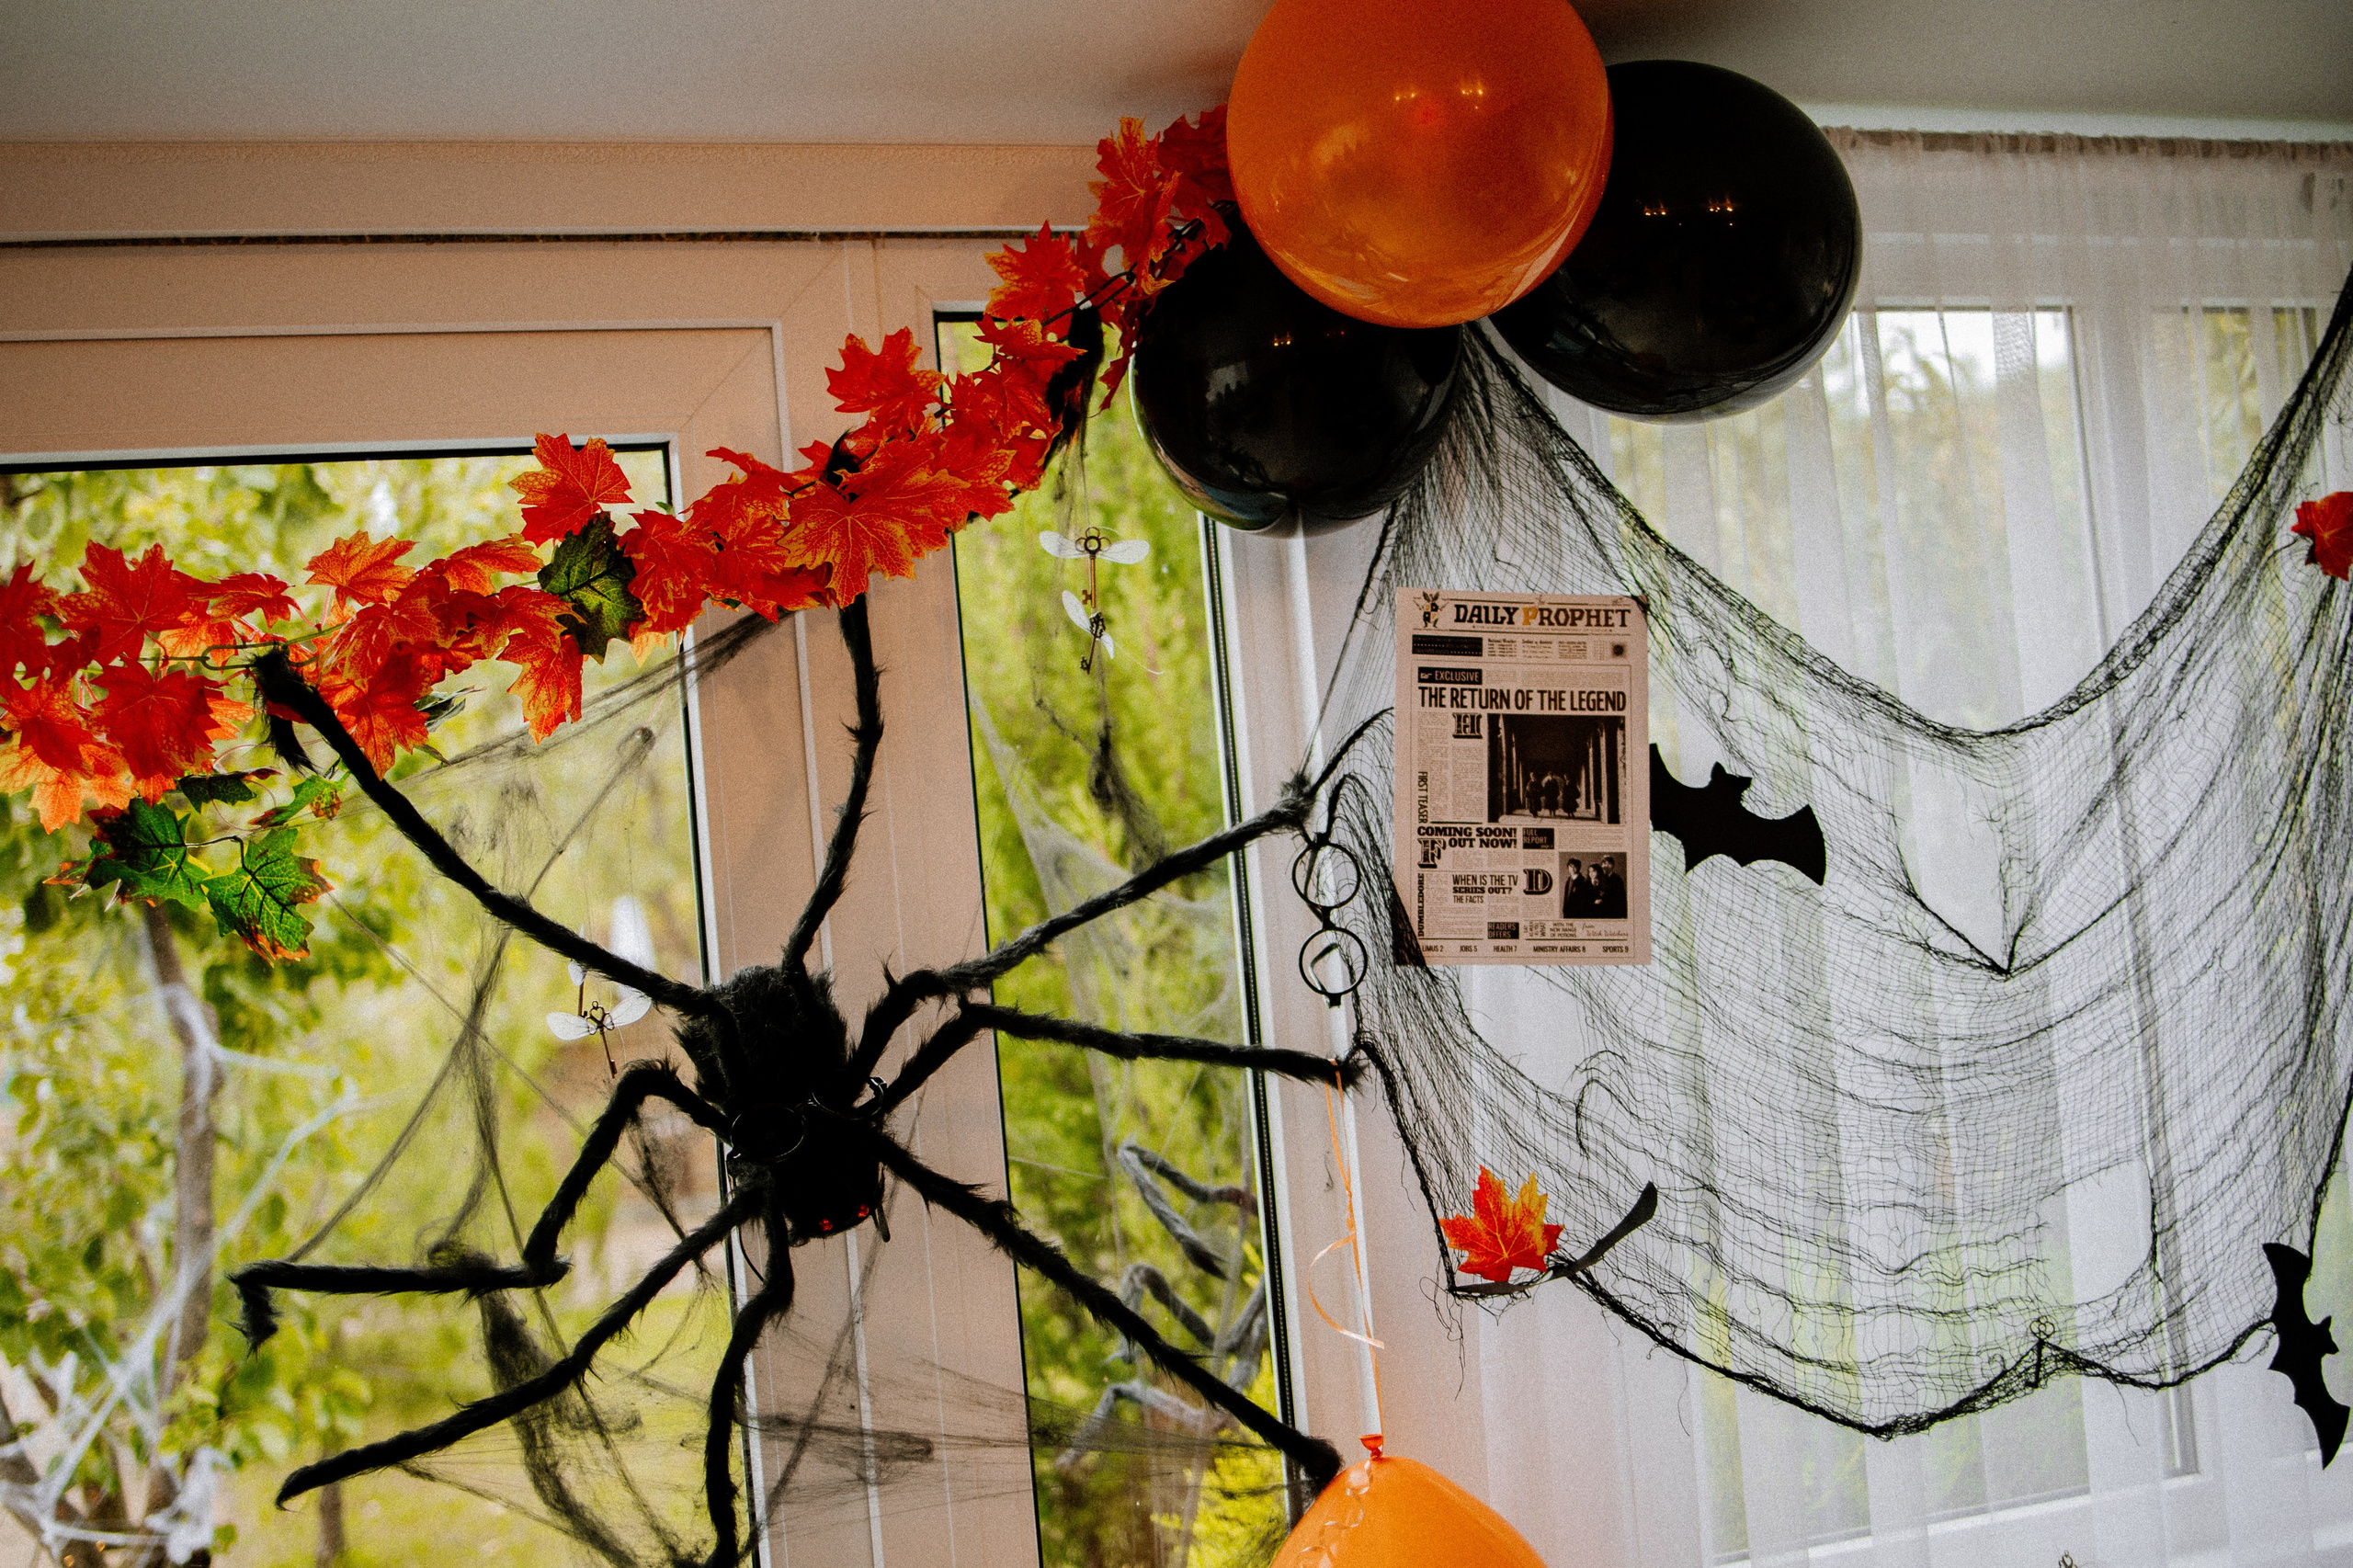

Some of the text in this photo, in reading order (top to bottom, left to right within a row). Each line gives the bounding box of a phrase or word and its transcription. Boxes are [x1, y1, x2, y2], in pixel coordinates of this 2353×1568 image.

[1454, 604, 1631, 628] DAILY PROPHET
[1435, 670, 1479, 682] EXCLUSIVE
[1418, 686, 1627, 711] THE RETURN OF THE LEGEND
[1417, 771, 1428, 824] FIRST TEASER
[1417, 826, 1518, 838] COMING SOON!
[1523, 828, 1538, 836] FULL
[1449, 837, 1518, 848] OUT NOW!
[1523, 835, 1548, 845] REPORT
[1452, 874, 1518, 886] WHEN IS THE TV
[1452, 886, 1485, 894] SERIES
[1452, 895, 1484, 903] THE FACTS
[1488, 930, 1512, 938] OFFERS
